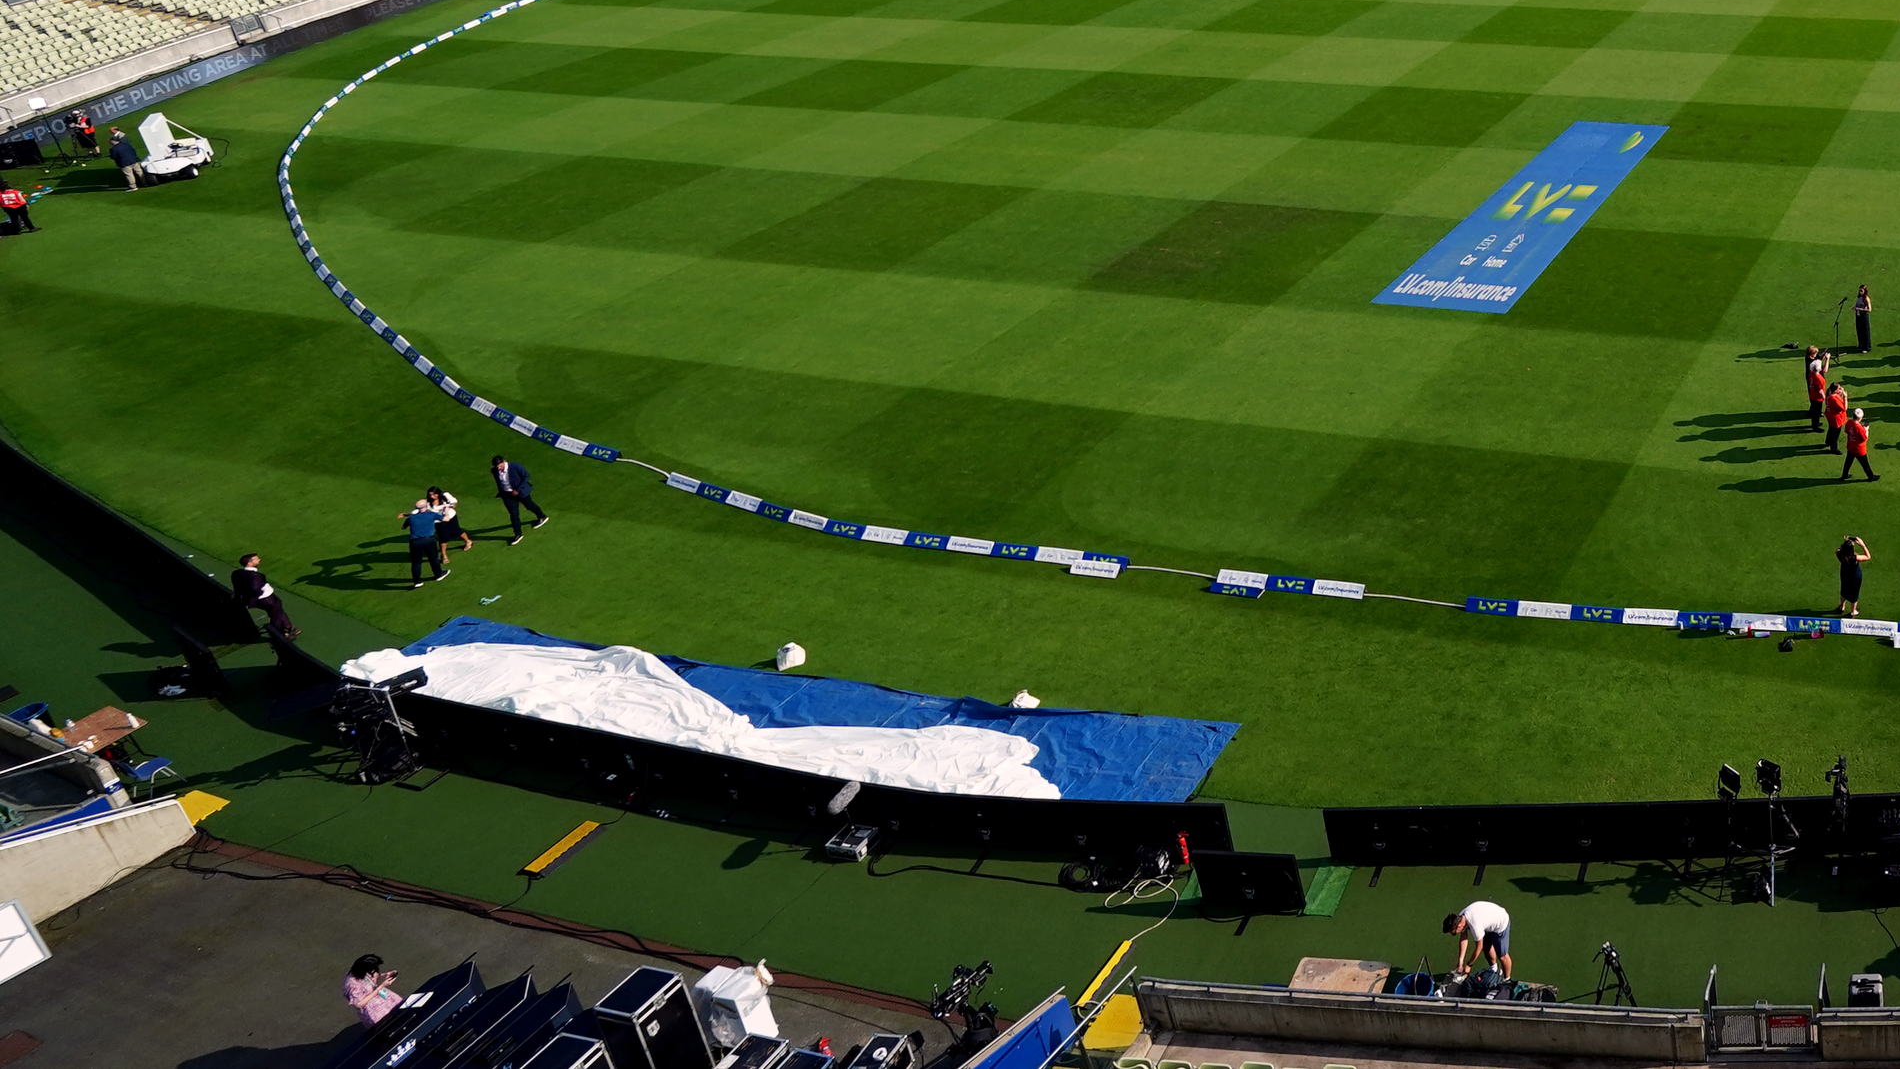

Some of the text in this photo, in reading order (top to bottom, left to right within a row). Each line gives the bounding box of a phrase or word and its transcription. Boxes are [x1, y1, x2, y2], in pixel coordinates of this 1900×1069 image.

[91, 44, 267, 118] THE PLAYING AREA AT
[1460, 254, 1507, 268] Car Home
[1393, 273, 1517, 302] LV.com/insurance
[1318, 584, 1359, 595] LV.com/insurance
